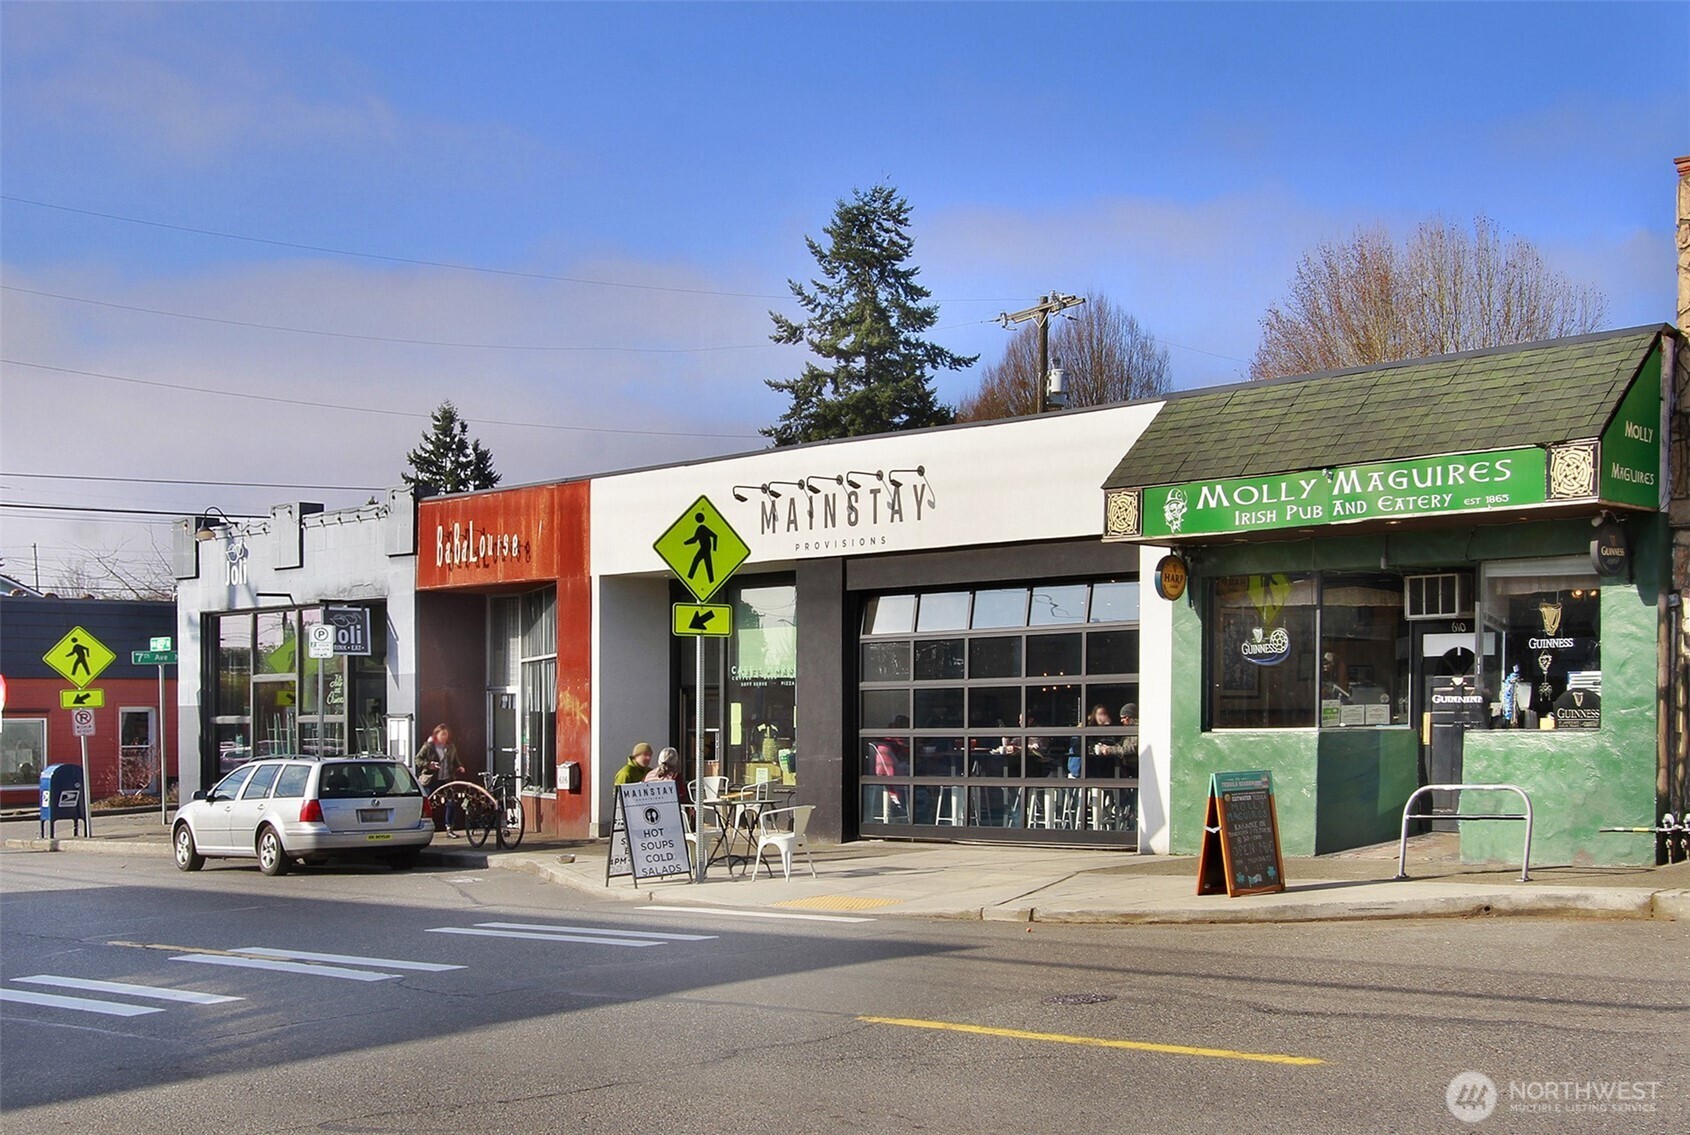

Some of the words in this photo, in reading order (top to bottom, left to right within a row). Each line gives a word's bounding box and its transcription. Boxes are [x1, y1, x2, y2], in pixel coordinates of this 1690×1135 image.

[1625, 420, 1654, 443] MOLLY
[1611, 462, 1655, 485] MAGUIRES
[1196, 479, 1317, 509] MOLLY
[1332, 459, 1512, 495] MAGUIRES
[761, 484, 925, 535] MAINSTAY
[1235, 509, 1276, 526] IRISH
[1286, 505, 1323, 521] PUB
[1332, 500, 1367, 516] AND
[1377, 493, 1453, 511] EATERY
[795, 536, 886, 551] PROVISIONS
[1451, 621, 1467, 632] 610
[1528, 638, 1574, 649] GUINNESS
[135, 653, 150, 662] 7th
[154, 653, 168, 661] Ave
[1557, 707, 1600, 719] GUINNESS
[623, 786, 674, 799] MAINSTAY
[643, 828, 664, 838] HOT
[640, 840, 675, 851] SOUPS
[645, 852, 674, 863] COLD
[641, 864, 682, 876] SALADS
